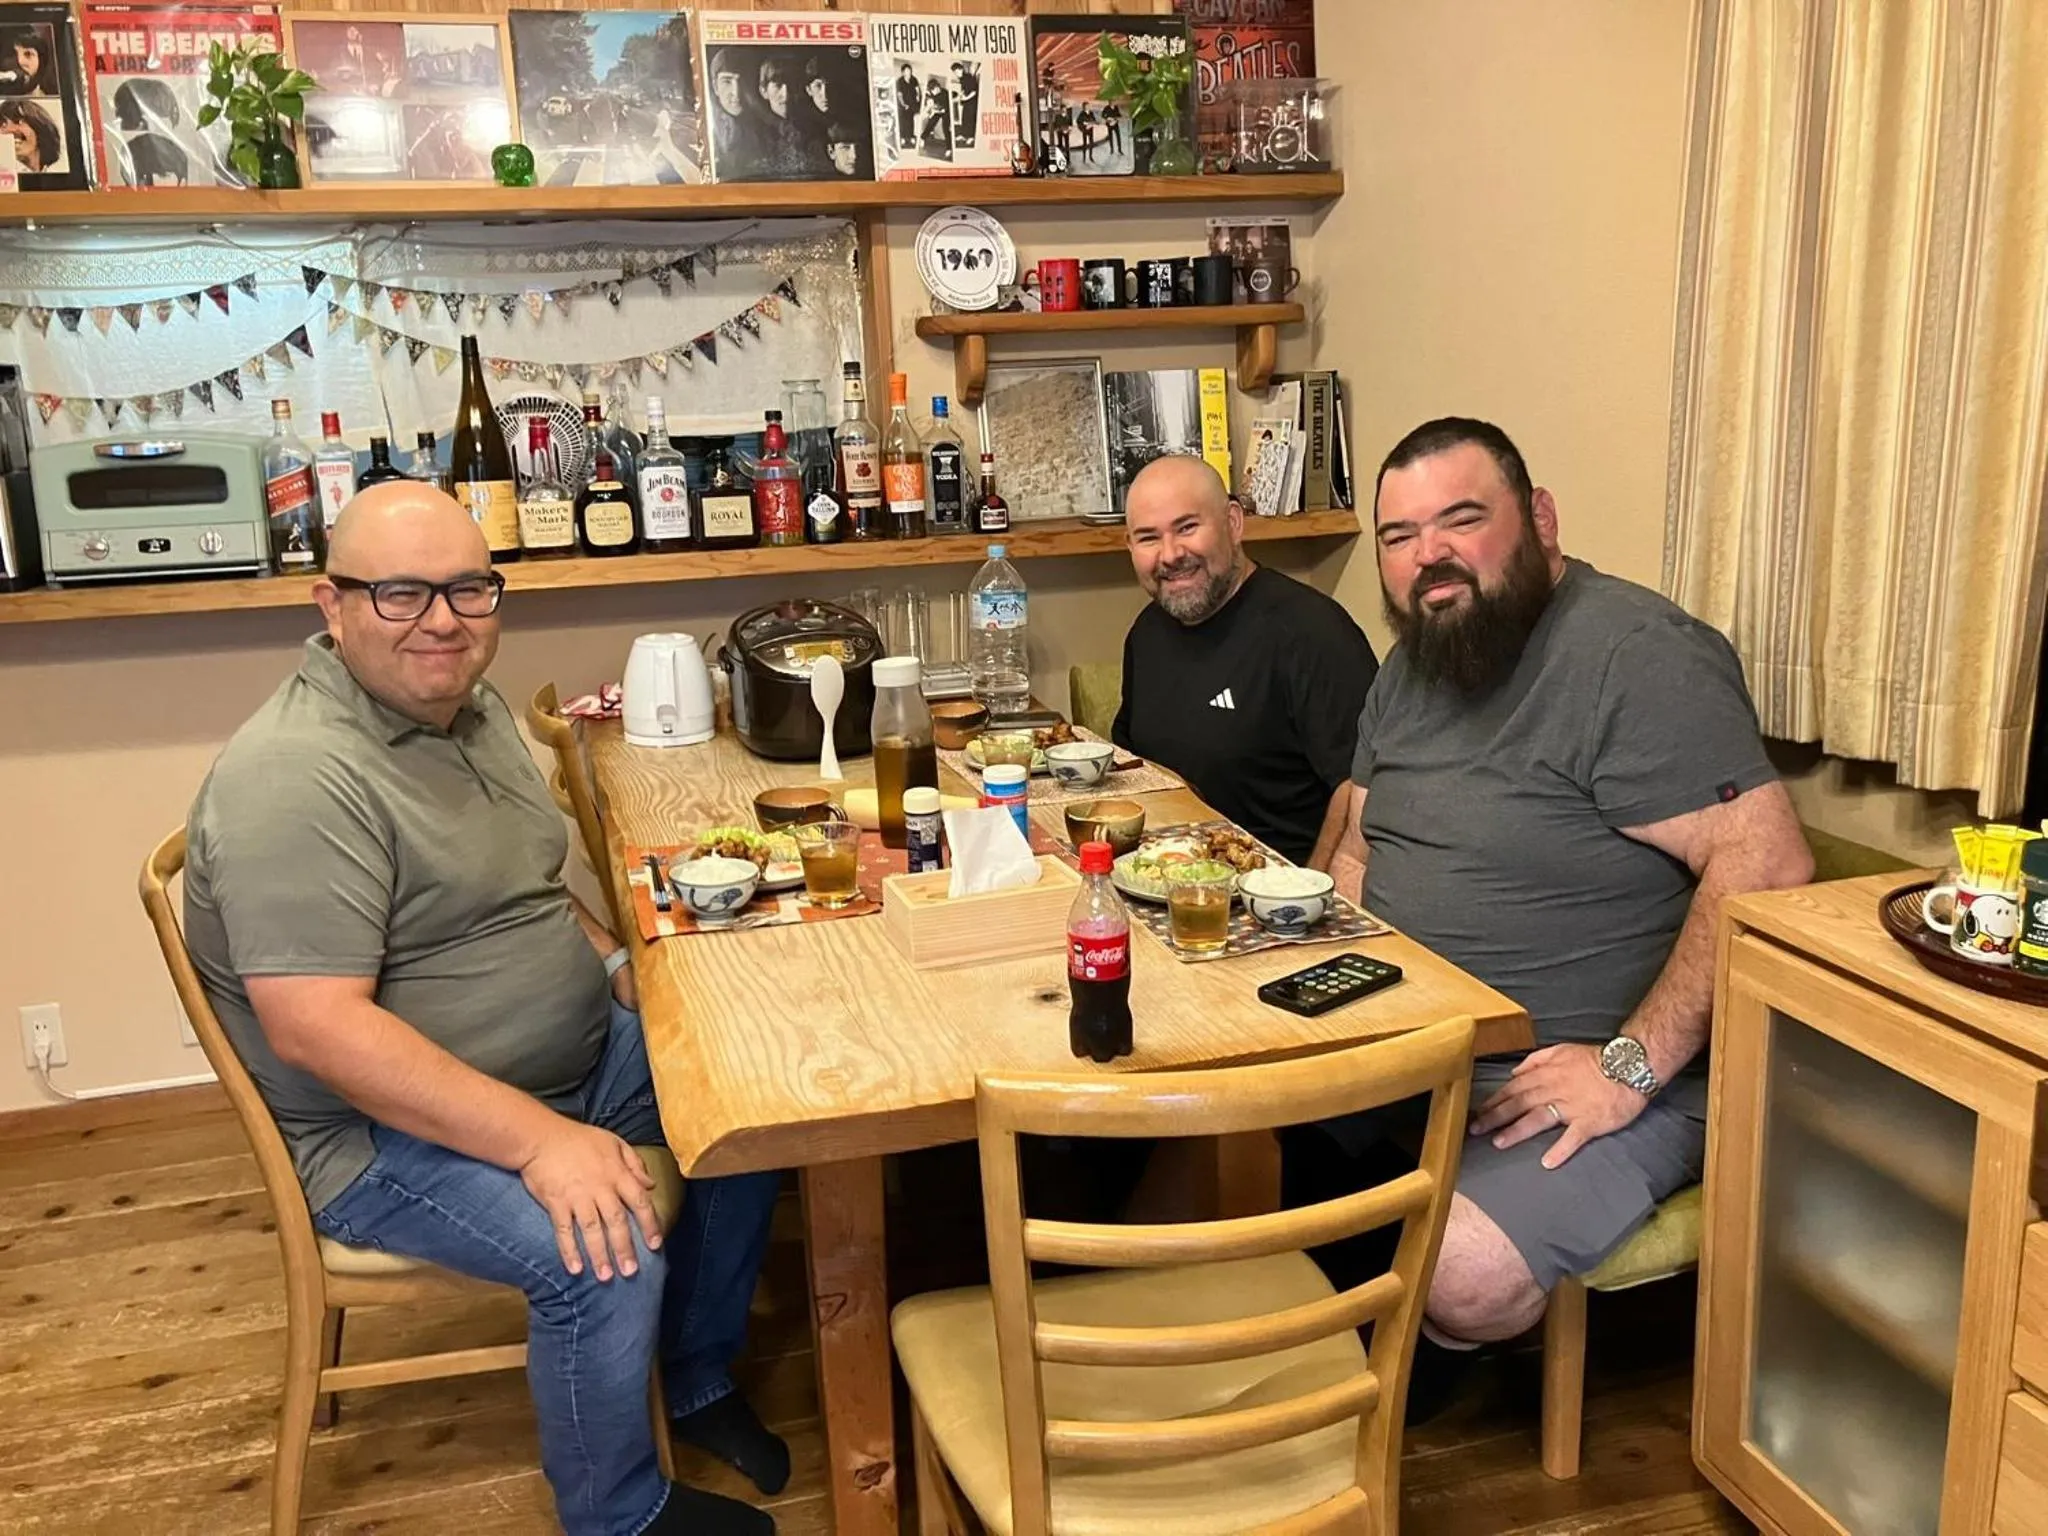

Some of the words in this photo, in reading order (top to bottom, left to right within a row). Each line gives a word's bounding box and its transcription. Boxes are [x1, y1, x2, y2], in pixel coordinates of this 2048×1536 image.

[736, 23, 863, 39] BEATLES!
[871, 23, 945, 53] LIVERPOOL
[948, 23, 978, 54] MAY
[984, 25, 1017, 54] 1960
[90, 31, 145, 55] THE
[95, 55, 107, 72] A
[992, 58, 1018, 81] JOHN
[981, 112, 1017, 135] GEORG
[1312, 387, 1323, 412] THE
[1312, 416, 1324, 470] BEATLES
[646, 477, 662, 492] JIM
[537, 516, 569, 524] Mark
[710, 510, 744, 521] ROYAL
[1085, 946, 1123, 966] Coca-Cola
